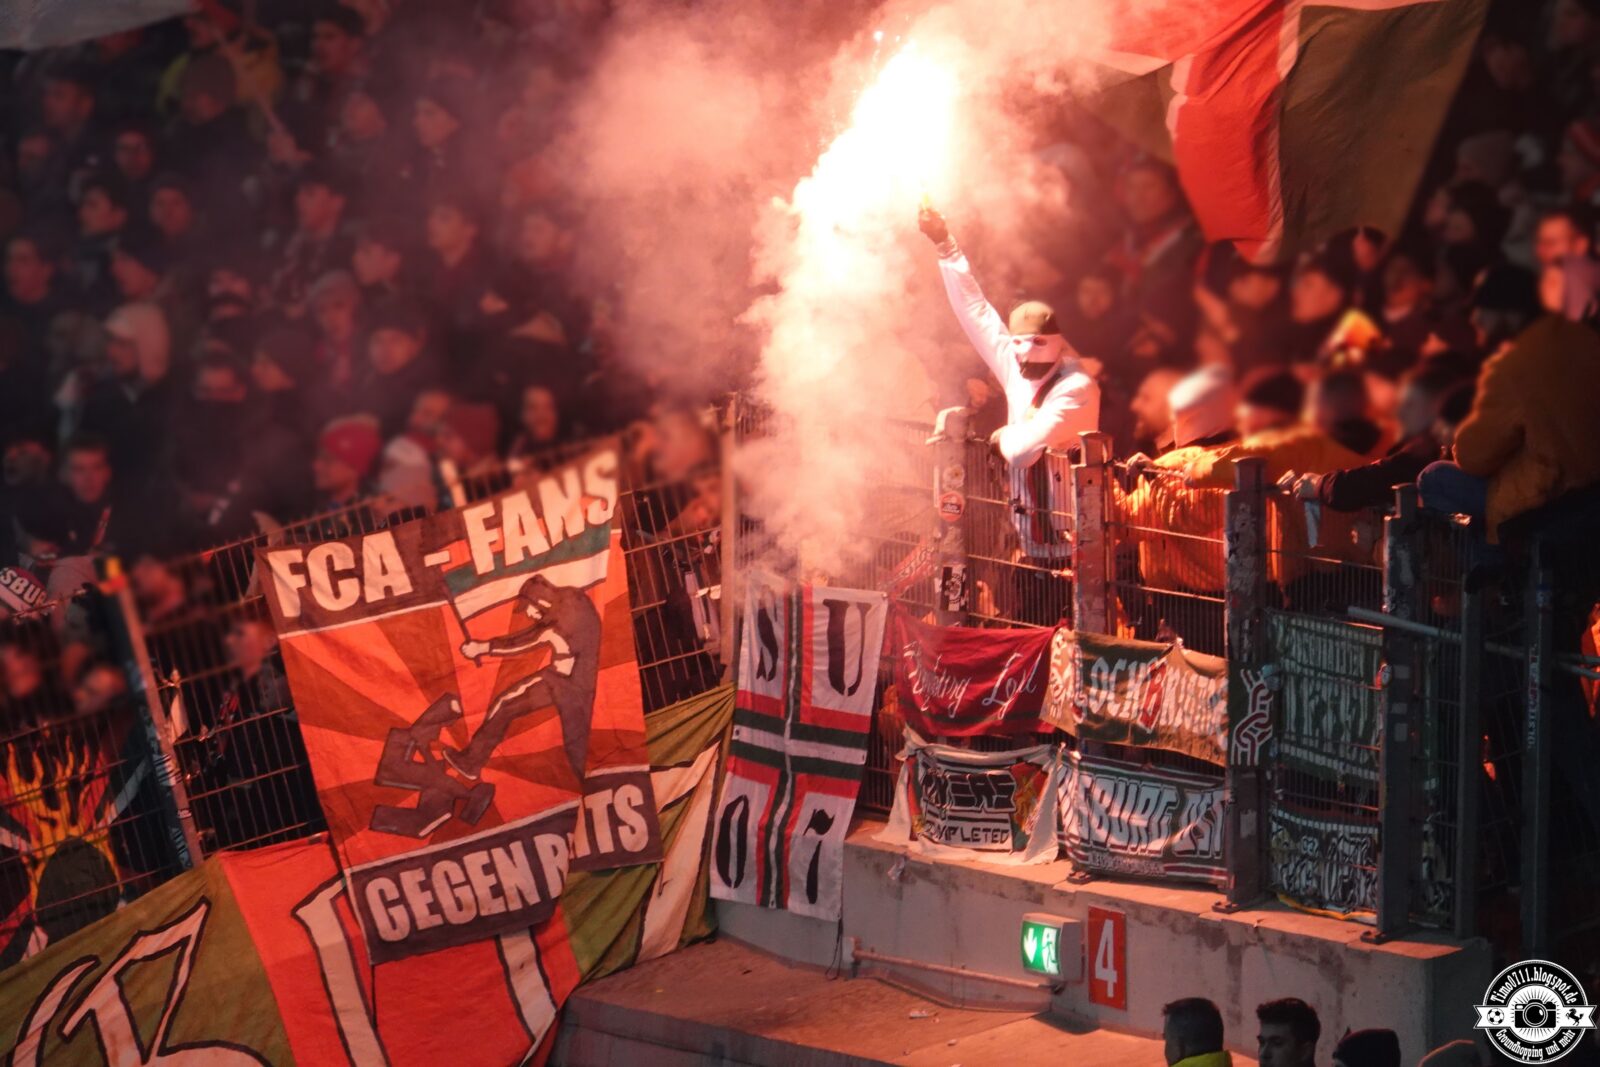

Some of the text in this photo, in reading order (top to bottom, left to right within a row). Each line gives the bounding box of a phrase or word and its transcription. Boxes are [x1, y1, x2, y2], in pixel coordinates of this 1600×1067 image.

[269, 531, 412, 618] FCA
[463, 452, 617, 575] FANS
[365, 840, 541, 942] GEGEN
[1095, 919, 1118, 998] 4
